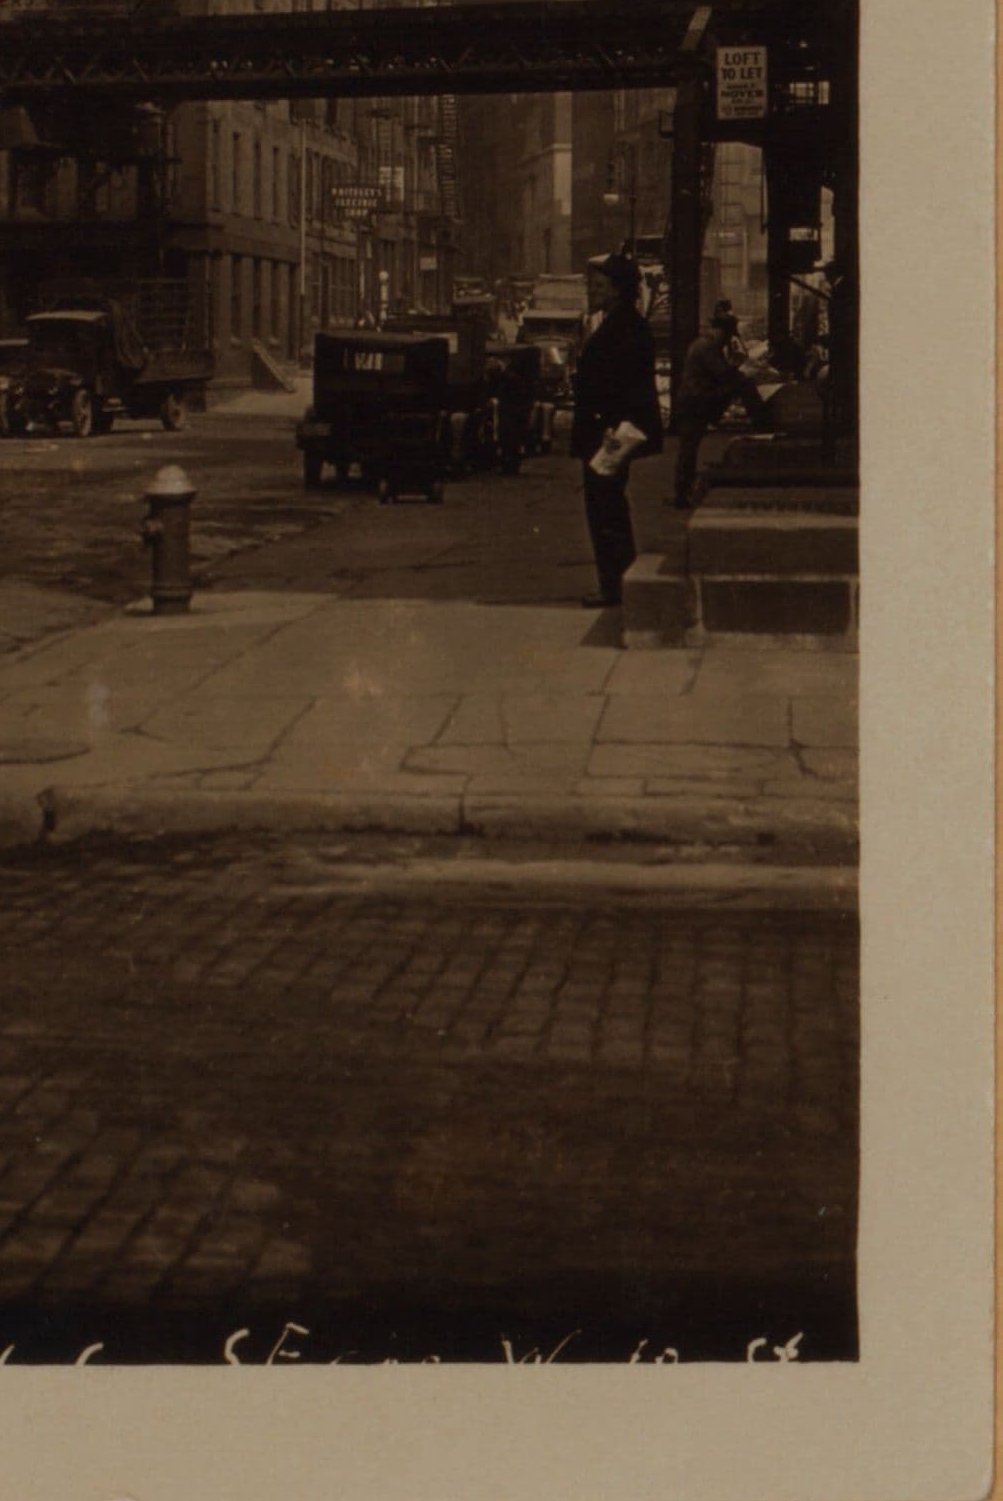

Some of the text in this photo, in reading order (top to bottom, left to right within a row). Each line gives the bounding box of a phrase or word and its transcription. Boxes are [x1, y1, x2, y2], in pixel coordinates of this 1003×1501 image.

[724, 51, 761, 66] LOFT
[721, 66, 762, 80] TO LET
